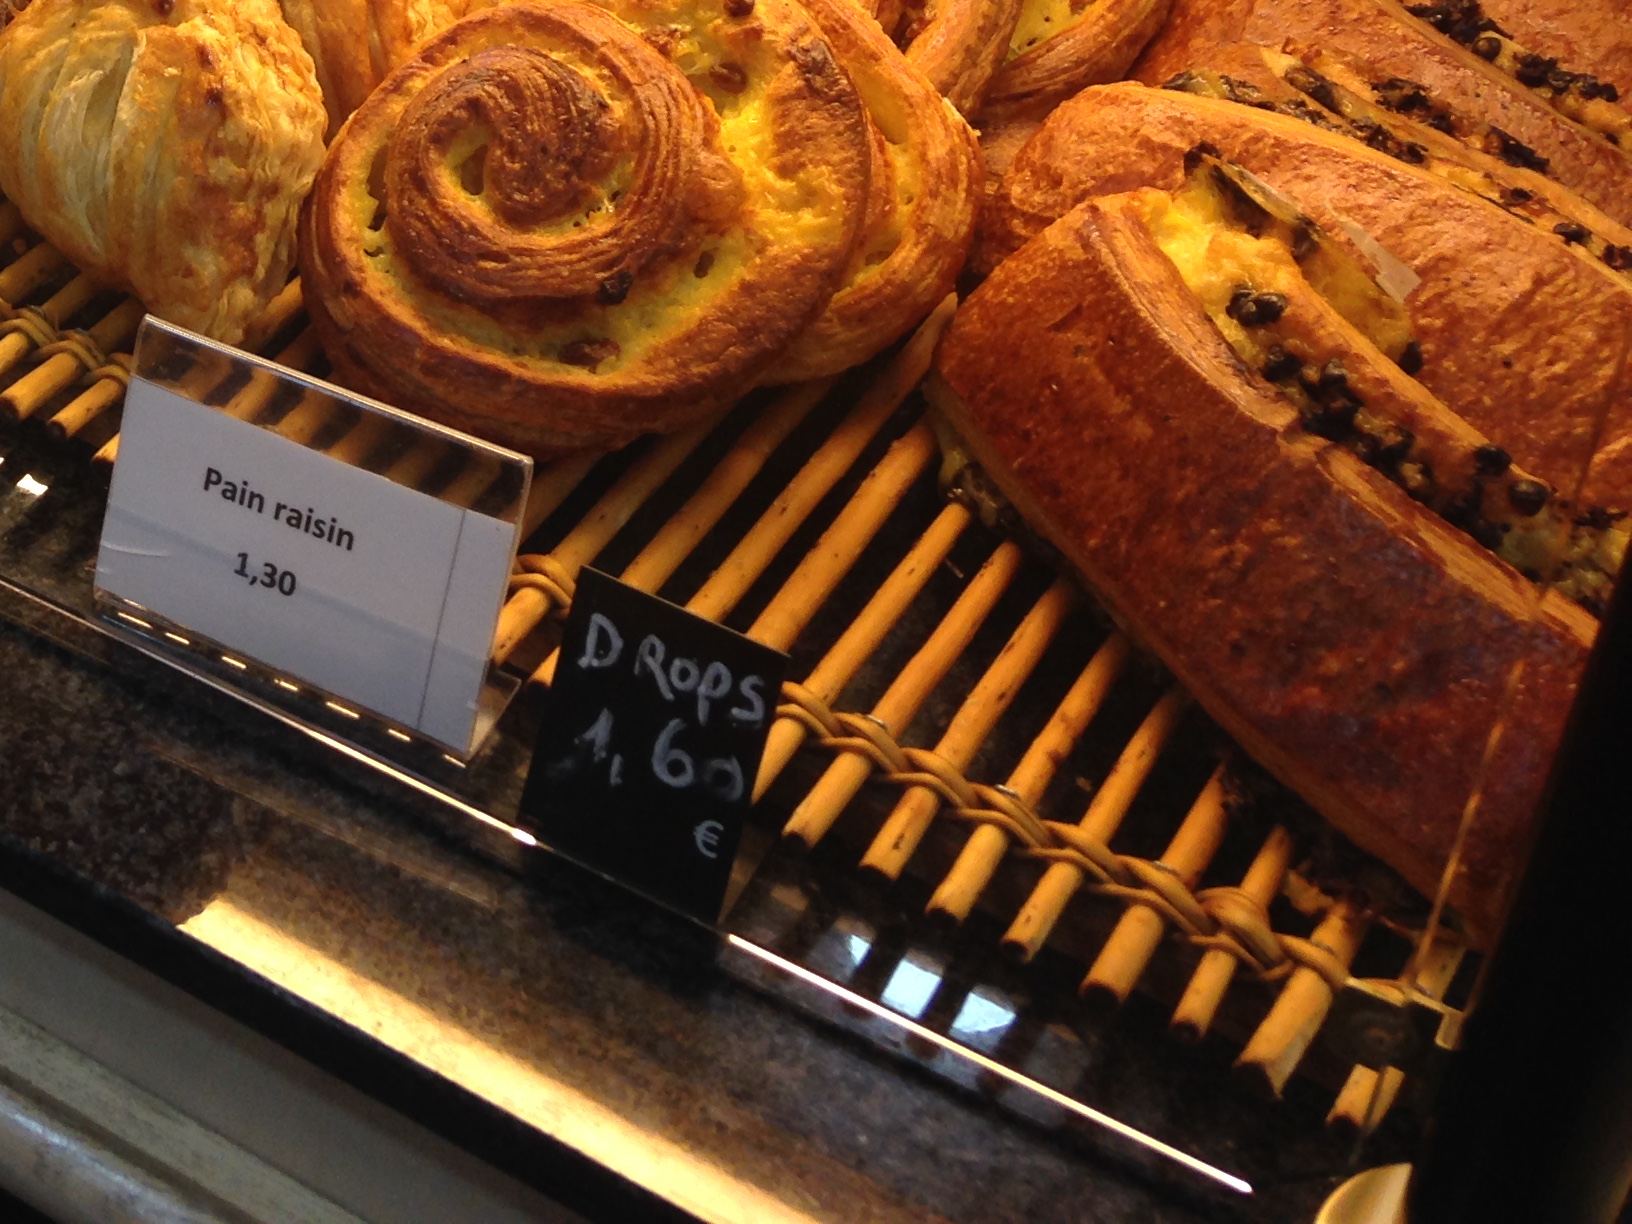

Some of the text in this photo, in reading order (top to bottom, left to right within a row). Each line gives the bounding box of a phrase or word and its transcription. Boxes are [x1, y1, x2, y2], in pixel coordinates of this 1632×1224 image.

[203, 466, 355, 552] Pain raisin
[233, 552, 297, 597] 1,30
[693, 820, 724, 858] €
